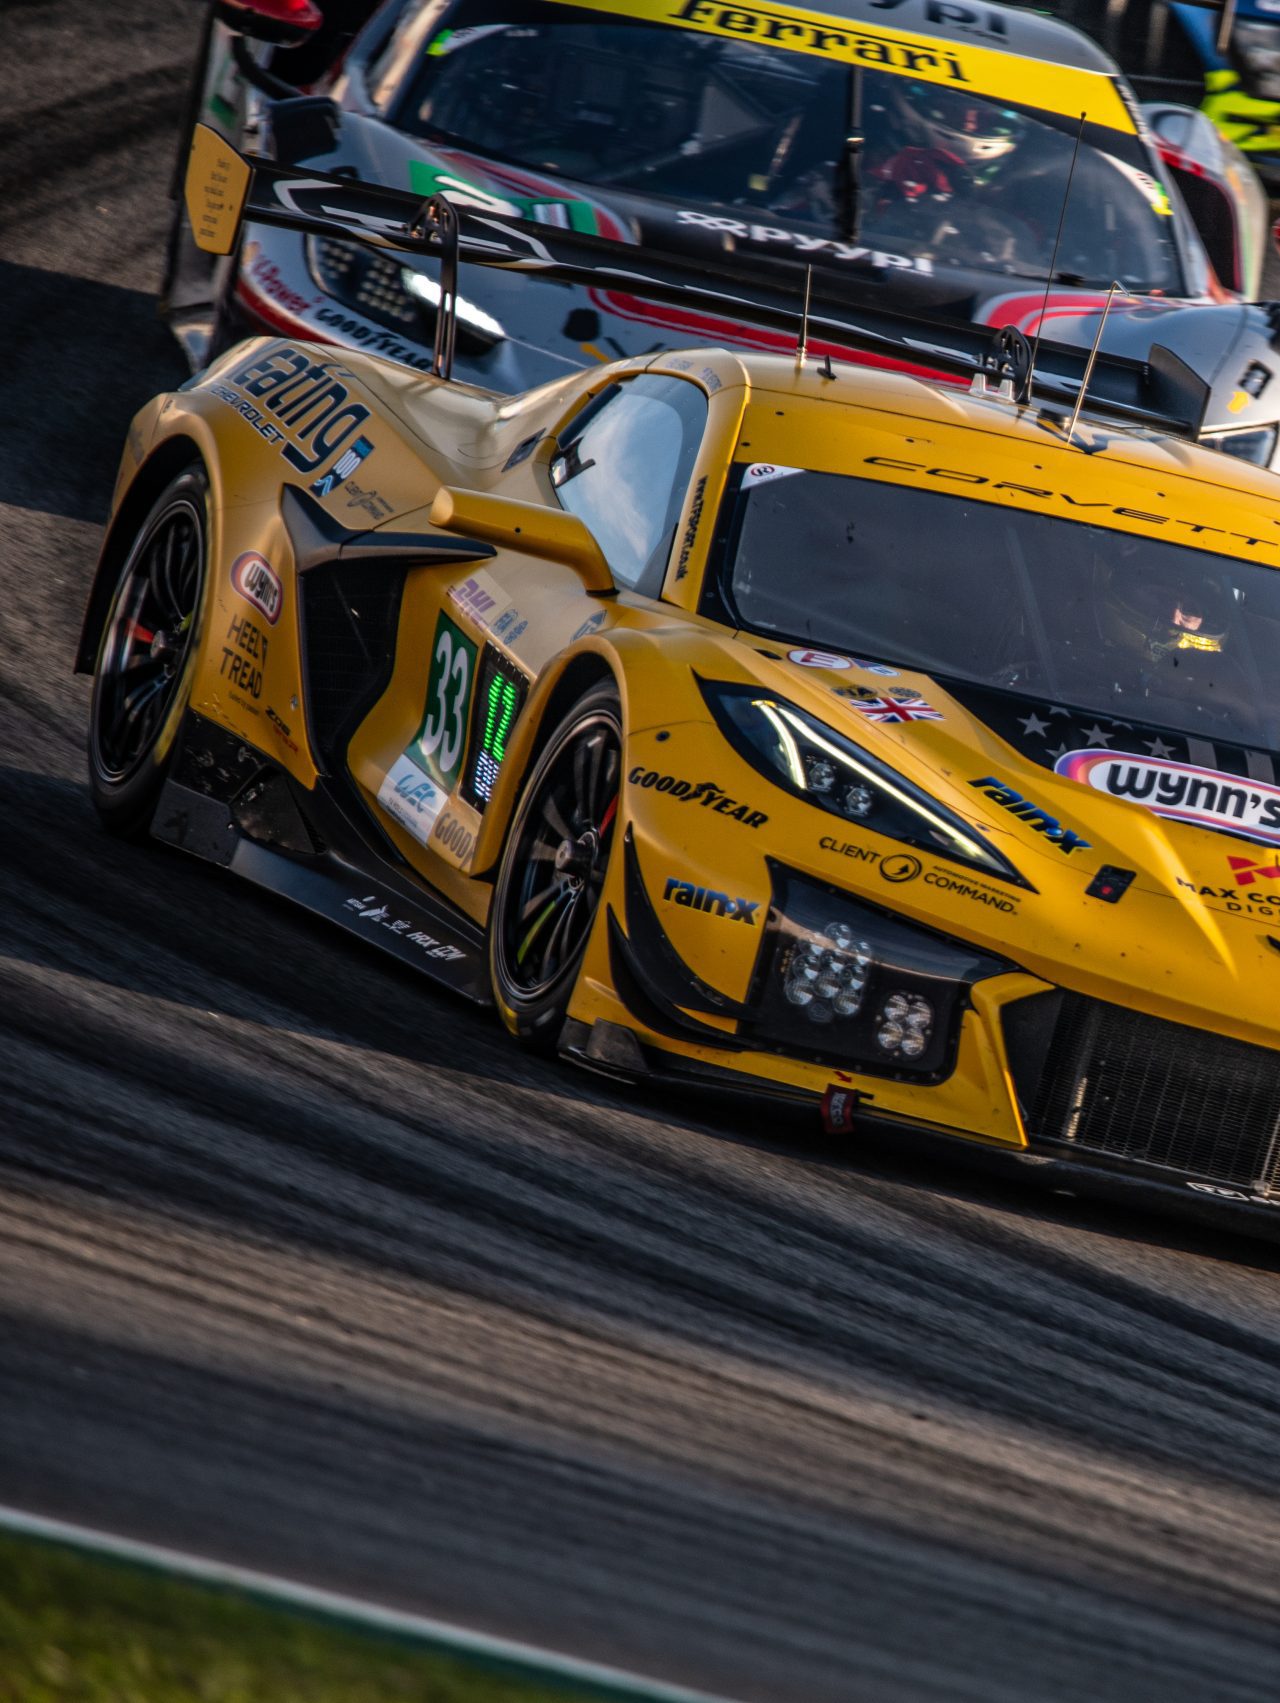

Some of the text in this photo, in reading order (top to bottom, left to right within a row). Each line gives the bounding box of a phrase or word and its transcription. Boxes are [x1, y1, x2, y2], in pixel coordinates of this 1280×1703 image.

[667, 0, 971, 83] Ferrari
[314, 308, 435, 371] GOODYEAR
[210, 383, 286, 445] CHEVROLET
[219, 646, 263, 700] TREAD
[421, 630, 470, 773] 33
[628, 766, 769, 831] GOODYEAR
[434, 812, 478, 868] GOOD
[819, 836, 1016, 914] CLIENT COMMAND
[1175, 876, 1239, 900] MAX
